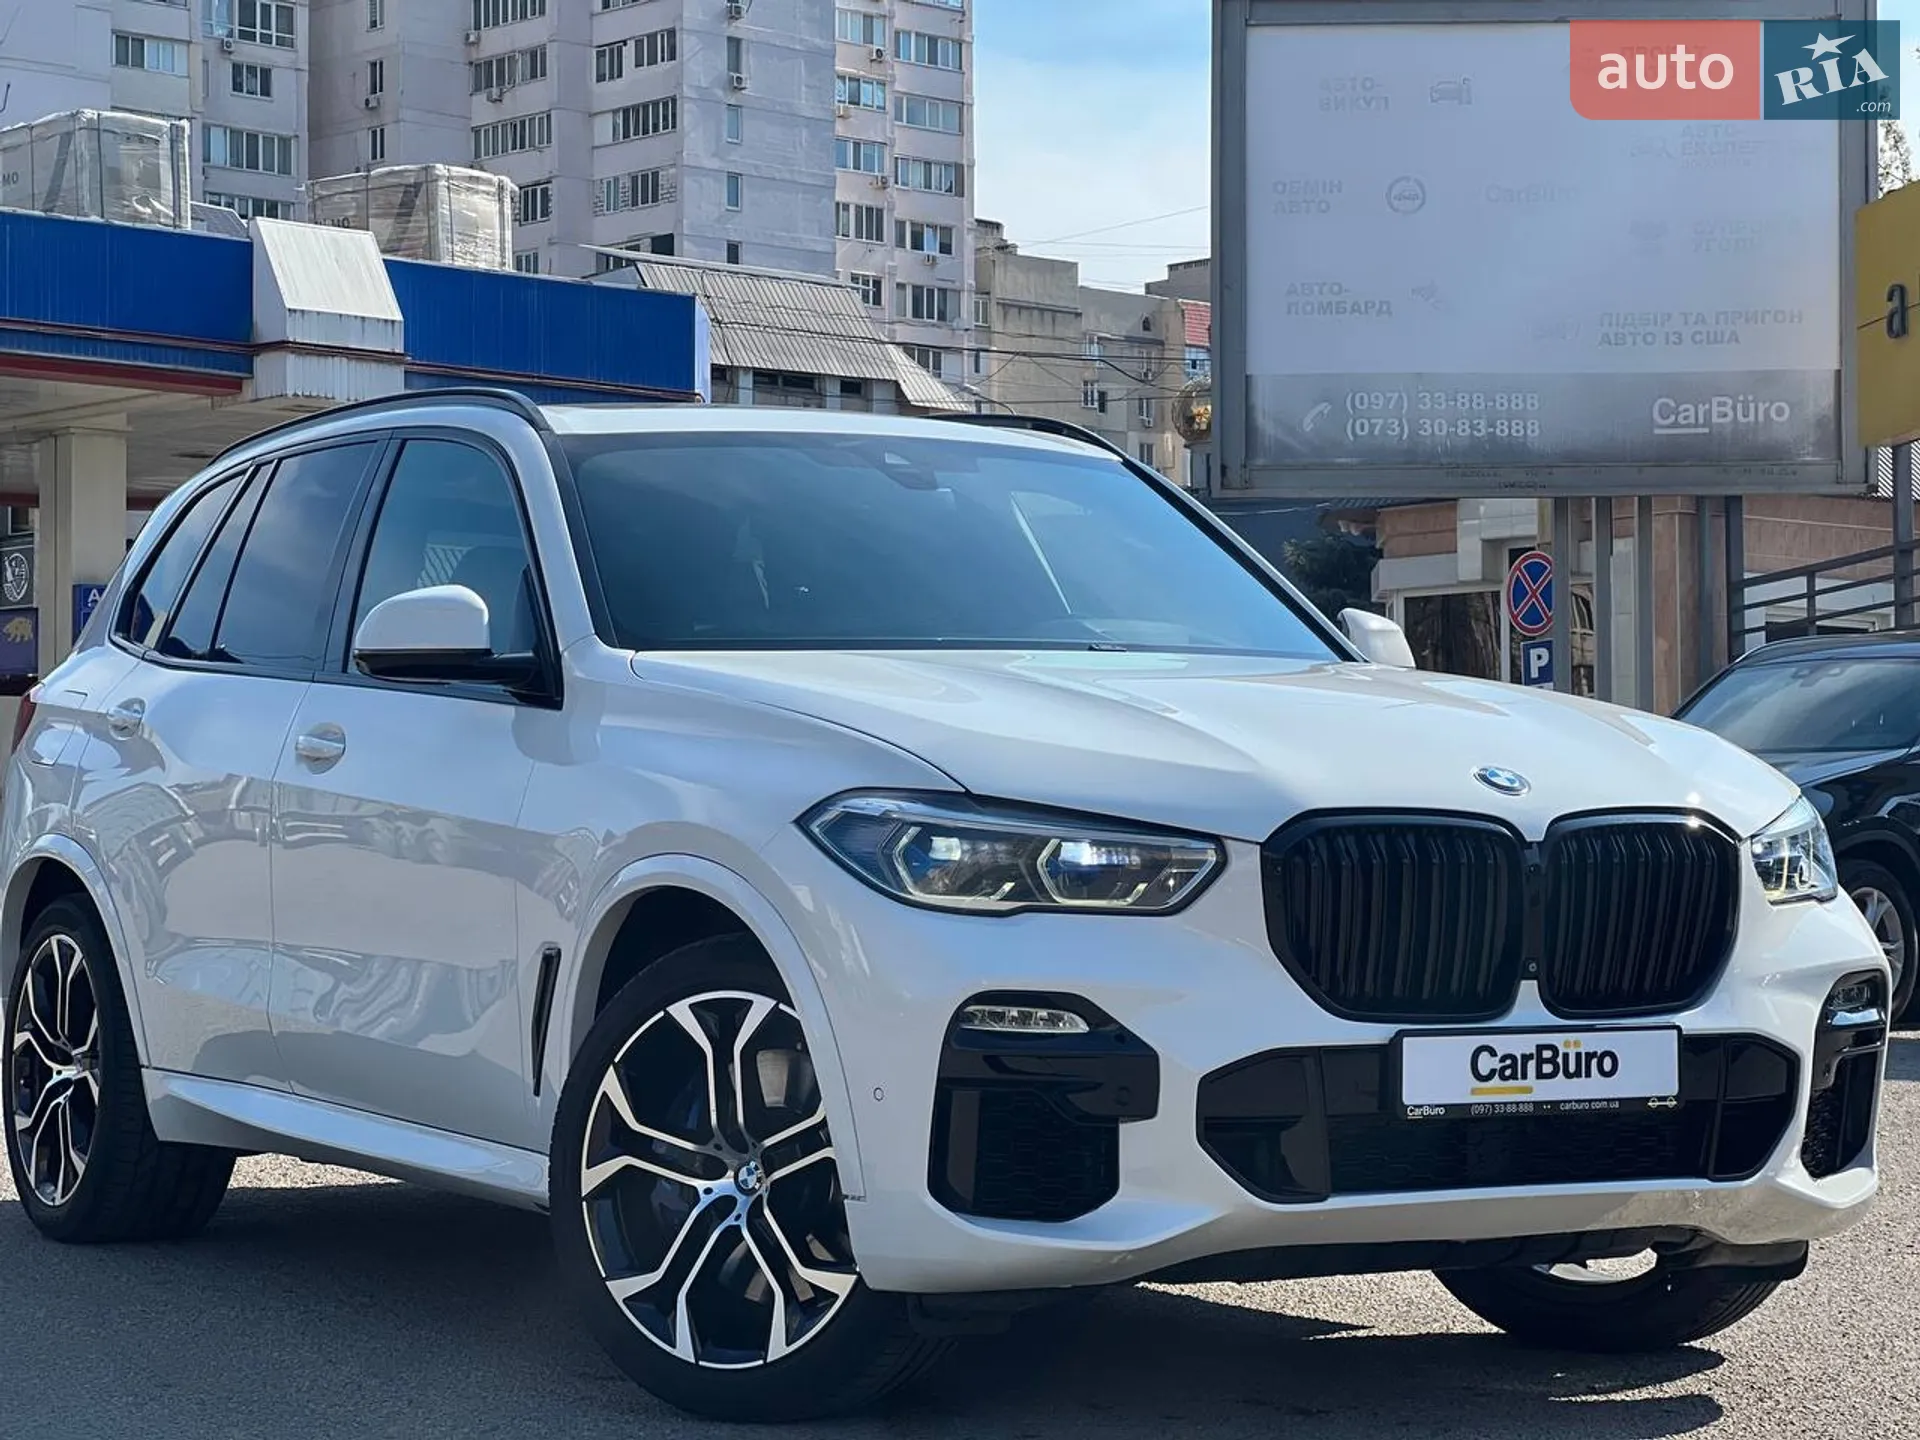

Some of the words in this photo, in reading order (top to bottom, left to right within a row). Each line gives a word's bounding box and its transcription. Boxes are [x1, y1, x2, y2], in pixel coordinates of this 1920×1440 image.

[1285, 282, 1351, 297] АВТО-
[1680, 312, 1708, 326] ТА
[1714, 309, 1803, 326] ПРИГОН
[1598, 331, 1657, 347] АВТО
[1665, 331, 1684, 346] ІЗ
[1690, 330, 1742, 345] США
[1345, 392, 1408, 414] (097)
[1418, 392, 1540, 410] 33-88-888
[1652, 394, 1790, 425] CarBüro
[1345, 418, 1409, 440] (073)
[1418, 418, 1540, 436] 30-83-888
[1530, 647, 1549, 678] P
[1470, 1040, 1619, 1082] CarBüro
